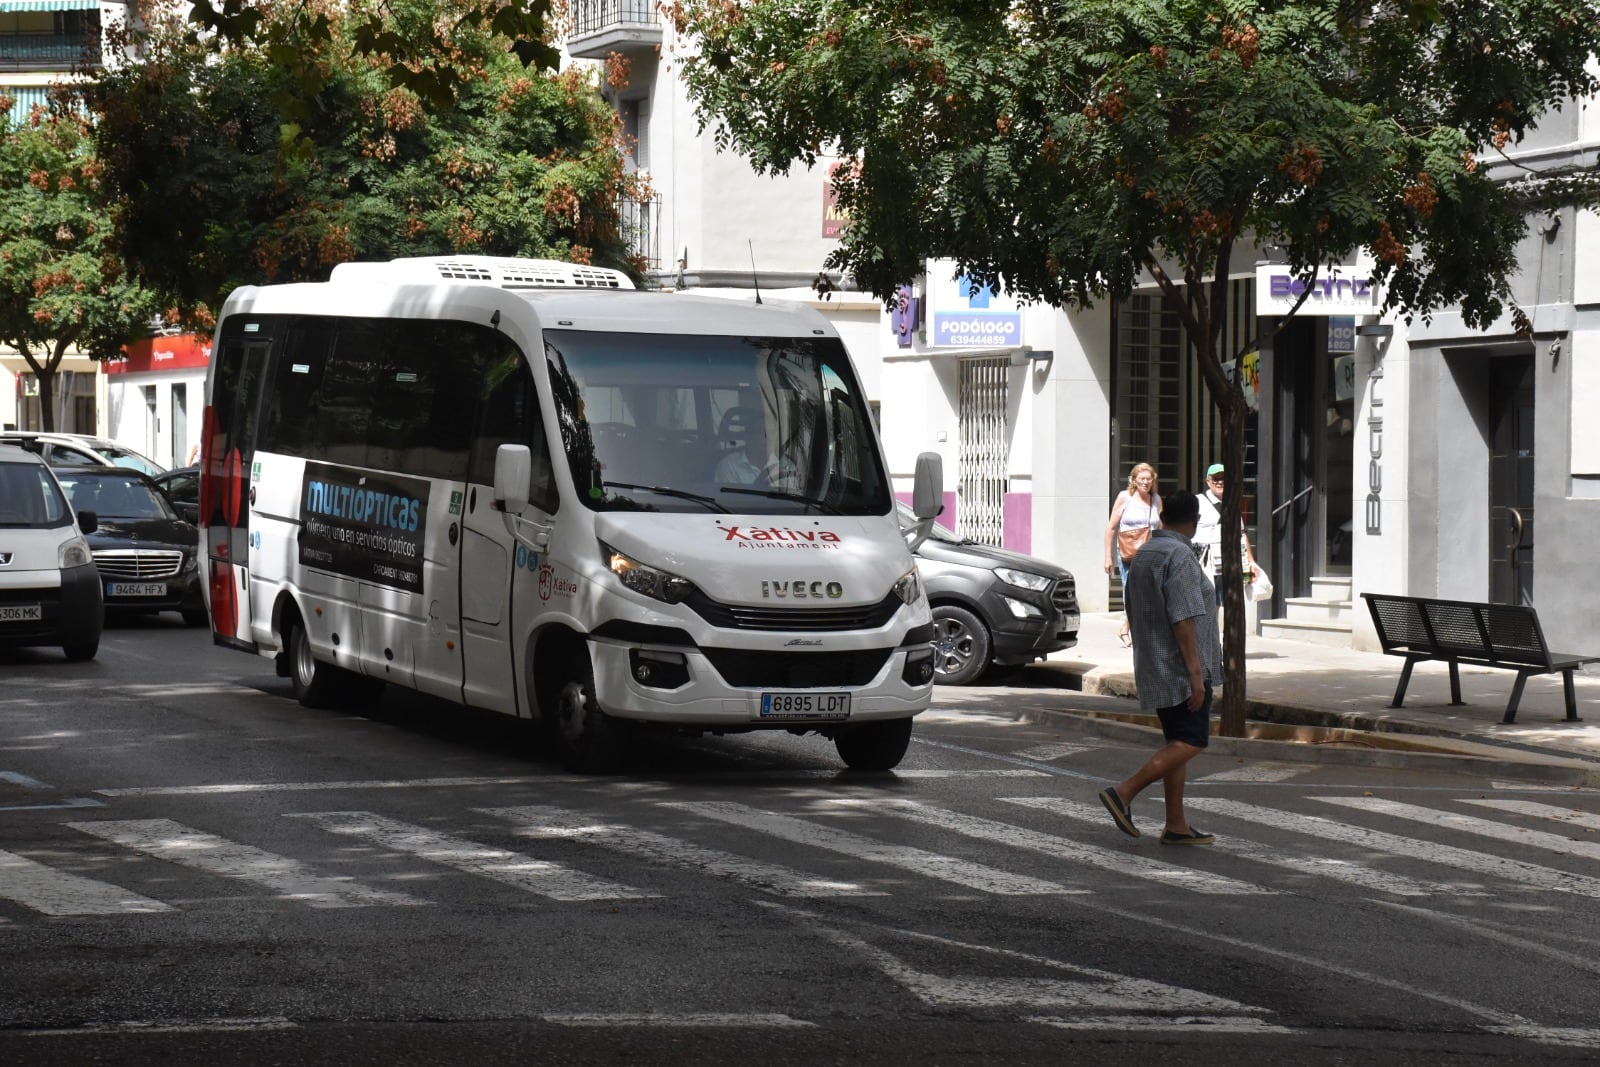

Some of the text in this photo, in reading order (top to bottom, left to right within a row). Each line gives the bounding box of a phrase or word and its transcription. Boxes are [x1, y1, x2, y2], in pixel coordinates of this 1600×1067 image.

[940, 319, 1015, 334] PODÓLOGO
[306, 517, 416, 558] número uno en servicios ópticos
[716, 525, 841, 543] Xàtiva
[738, 541, 840, 550] Ajuntament
[145, 584, 163, 594] HFX
[553, 576, 577, 593] Xàtiva
[761, 580, 843, 599] IVECO
[23, 607, 39, 618] MK
[773, 696, 847, 711] 6895 LDT
